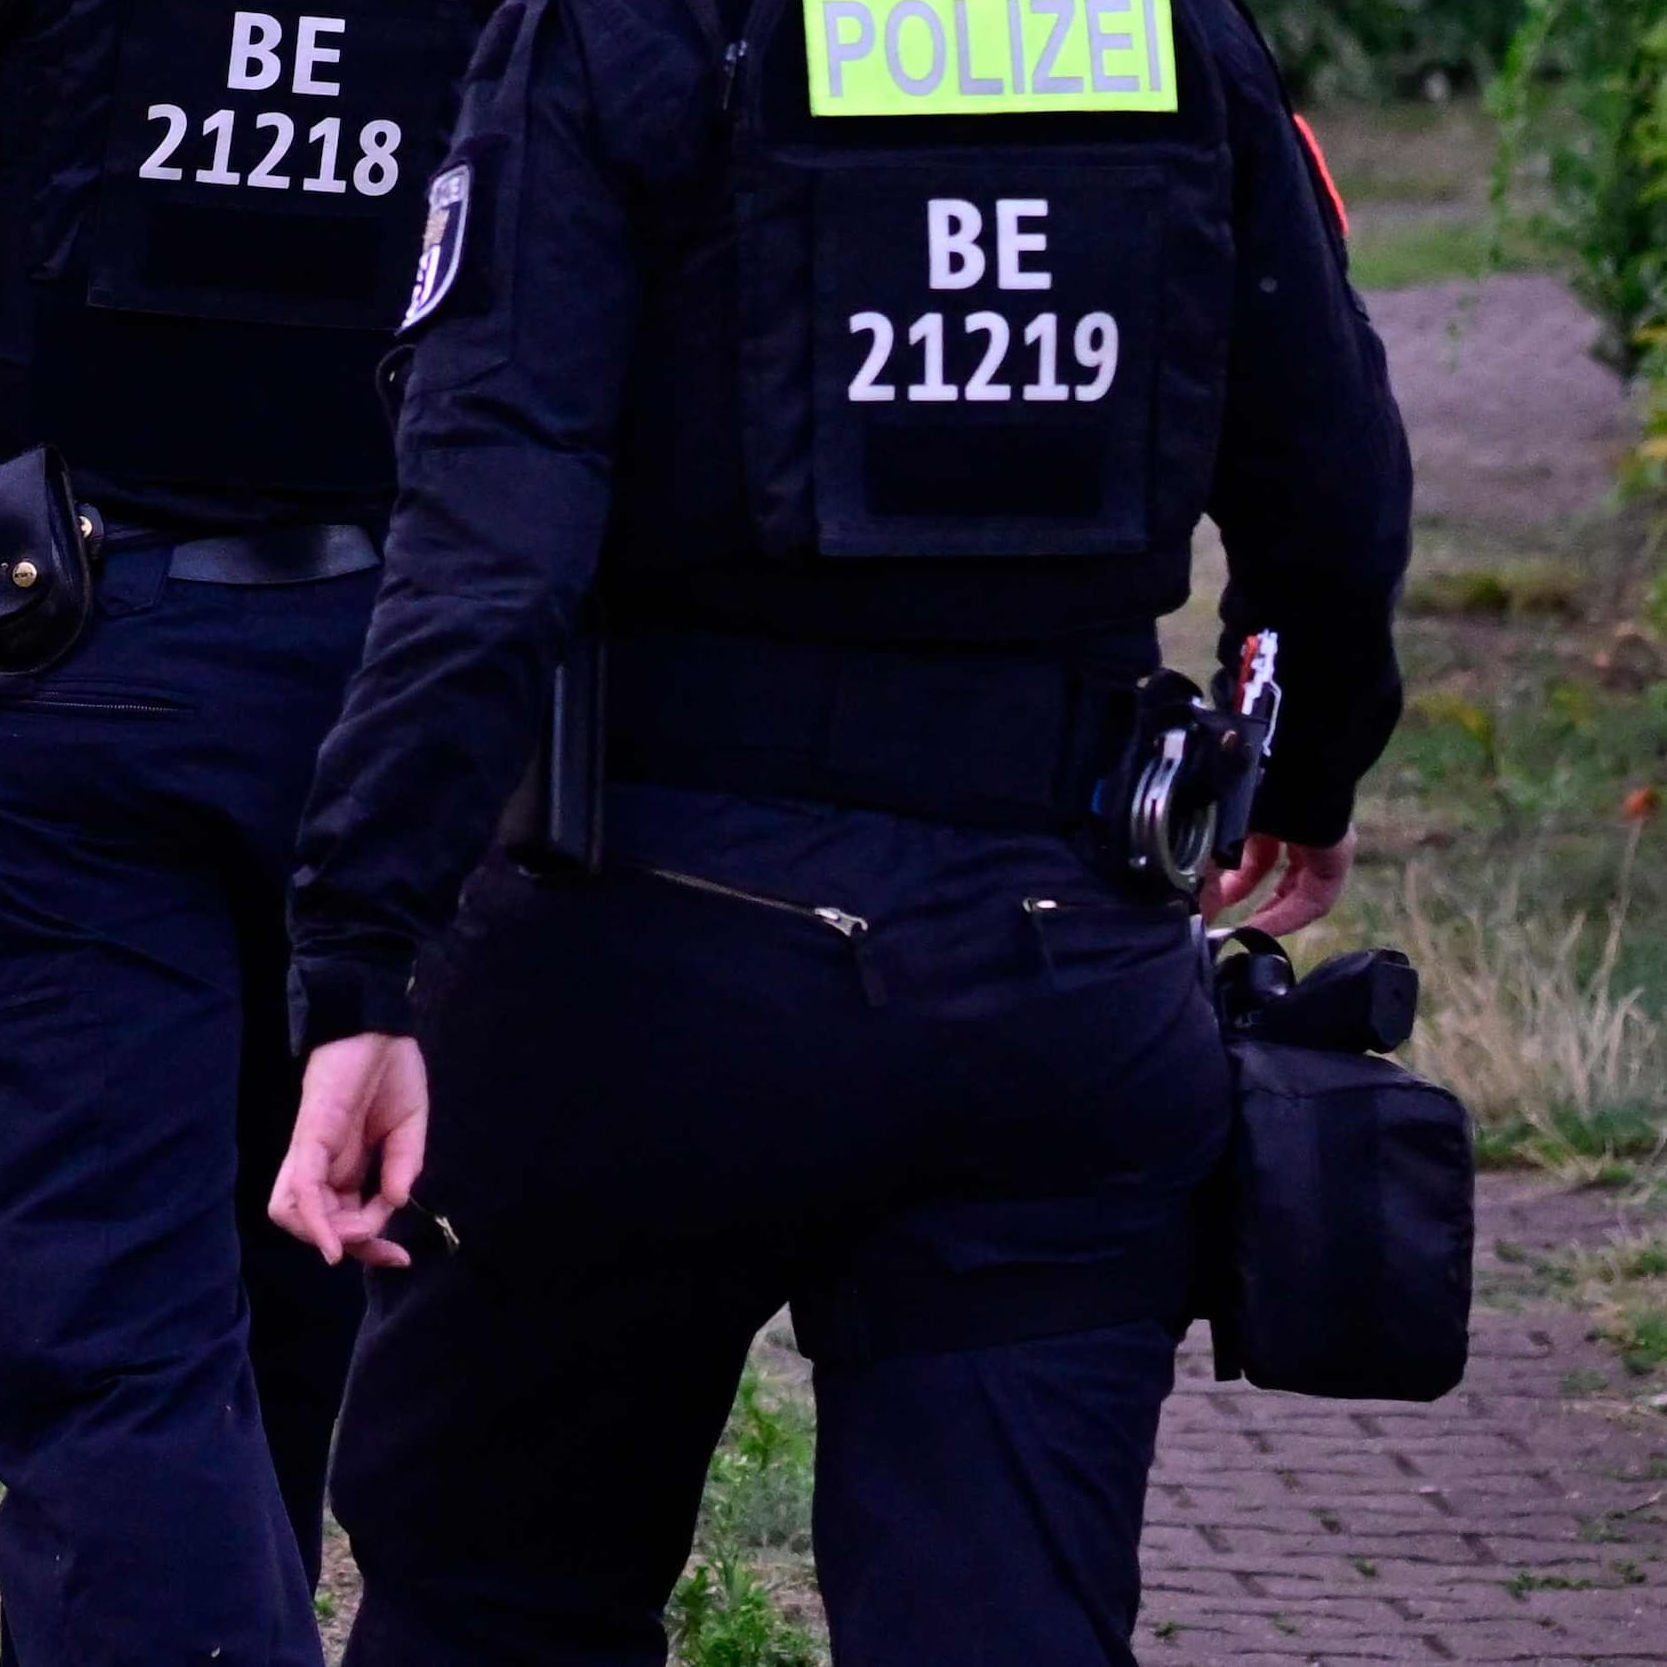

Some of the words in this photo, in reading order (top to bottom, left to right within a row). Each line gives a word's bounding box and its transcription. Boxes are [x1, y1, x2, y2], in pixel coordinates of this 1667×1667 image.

[227, 11, 346, 97] BE
[138, 103, 402, 197] 21218
[927, 198, 1052, 290] BE
[847, 310, 1120, 402] 21219
